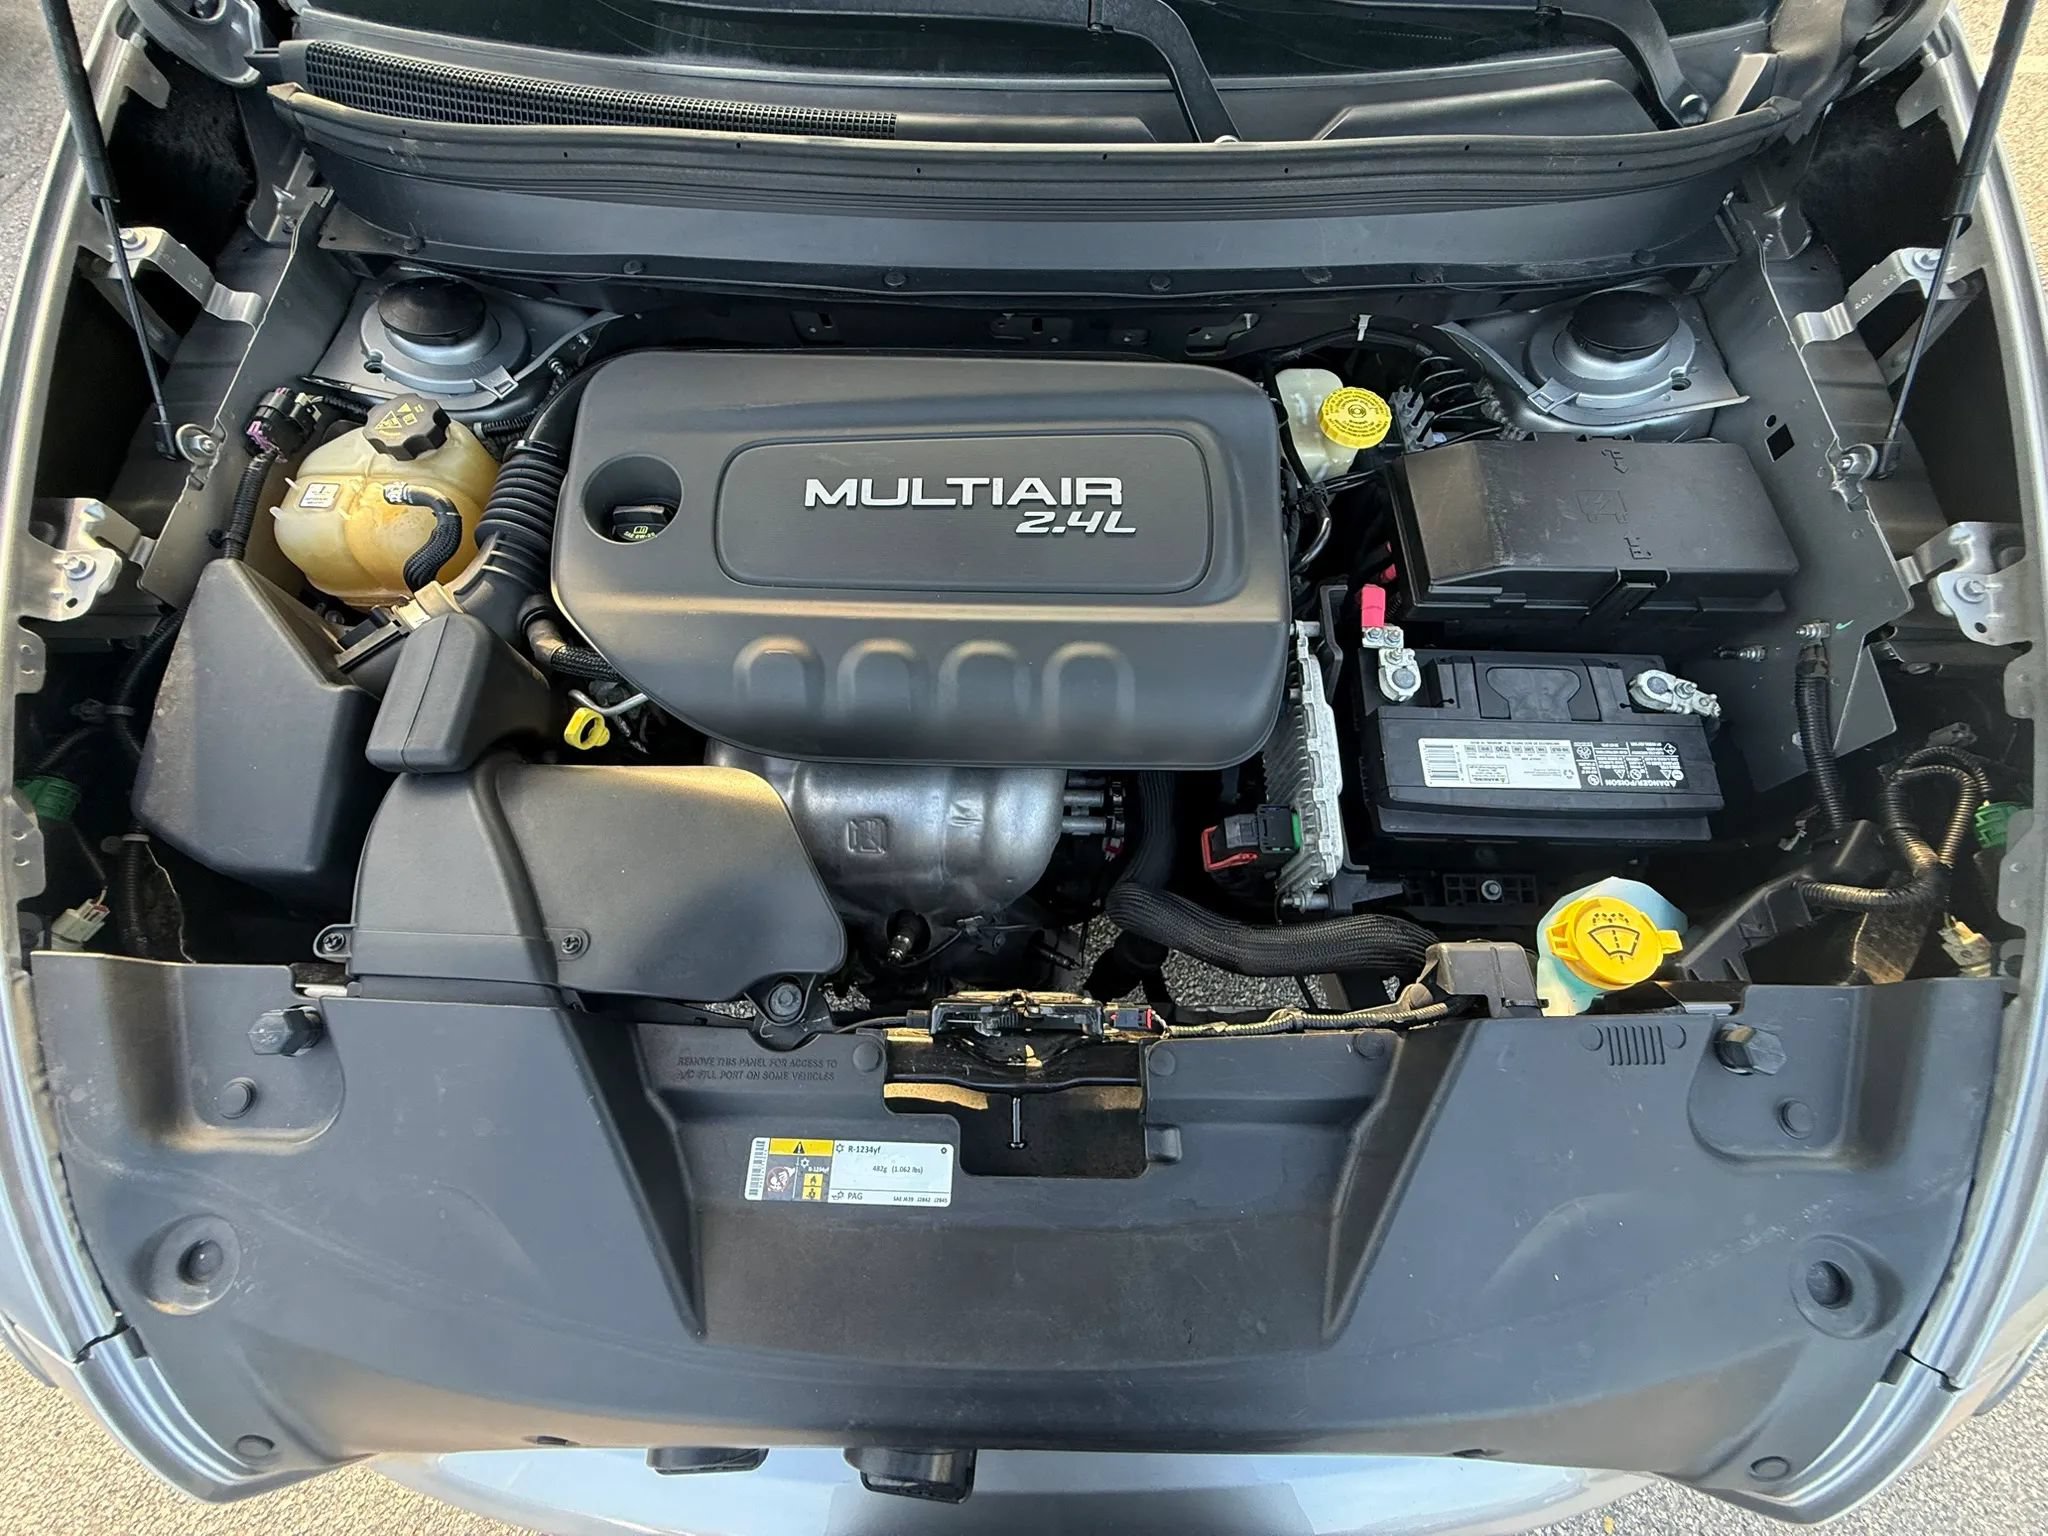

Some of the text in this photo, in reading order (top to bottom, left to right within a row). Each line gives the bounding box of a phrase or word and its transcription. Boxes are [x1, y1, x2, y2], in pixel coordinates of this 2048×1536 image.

[804, 477, 1123, 507] MULTIAIR
[1015, 511, 1137, 534] 2.4L
[678, 1056, 838, 1069] REMOVE THIS PANEL FOR ACCESS TO
[697, 1069, 717, 1080] FILL
[720, 1070, 744, 1080] PORT
[746, 1070, 760, 1080] ON
[762, 1070, 789, 1081] SOME
[792, 1071, 835, 1081] VEHICLES
[848, 1145, 881, 1154] R-1234yf
[872, 1165, 924, 1174] 482g (1.062 lbs)
[847, 1192, 863, 1201] PAG
